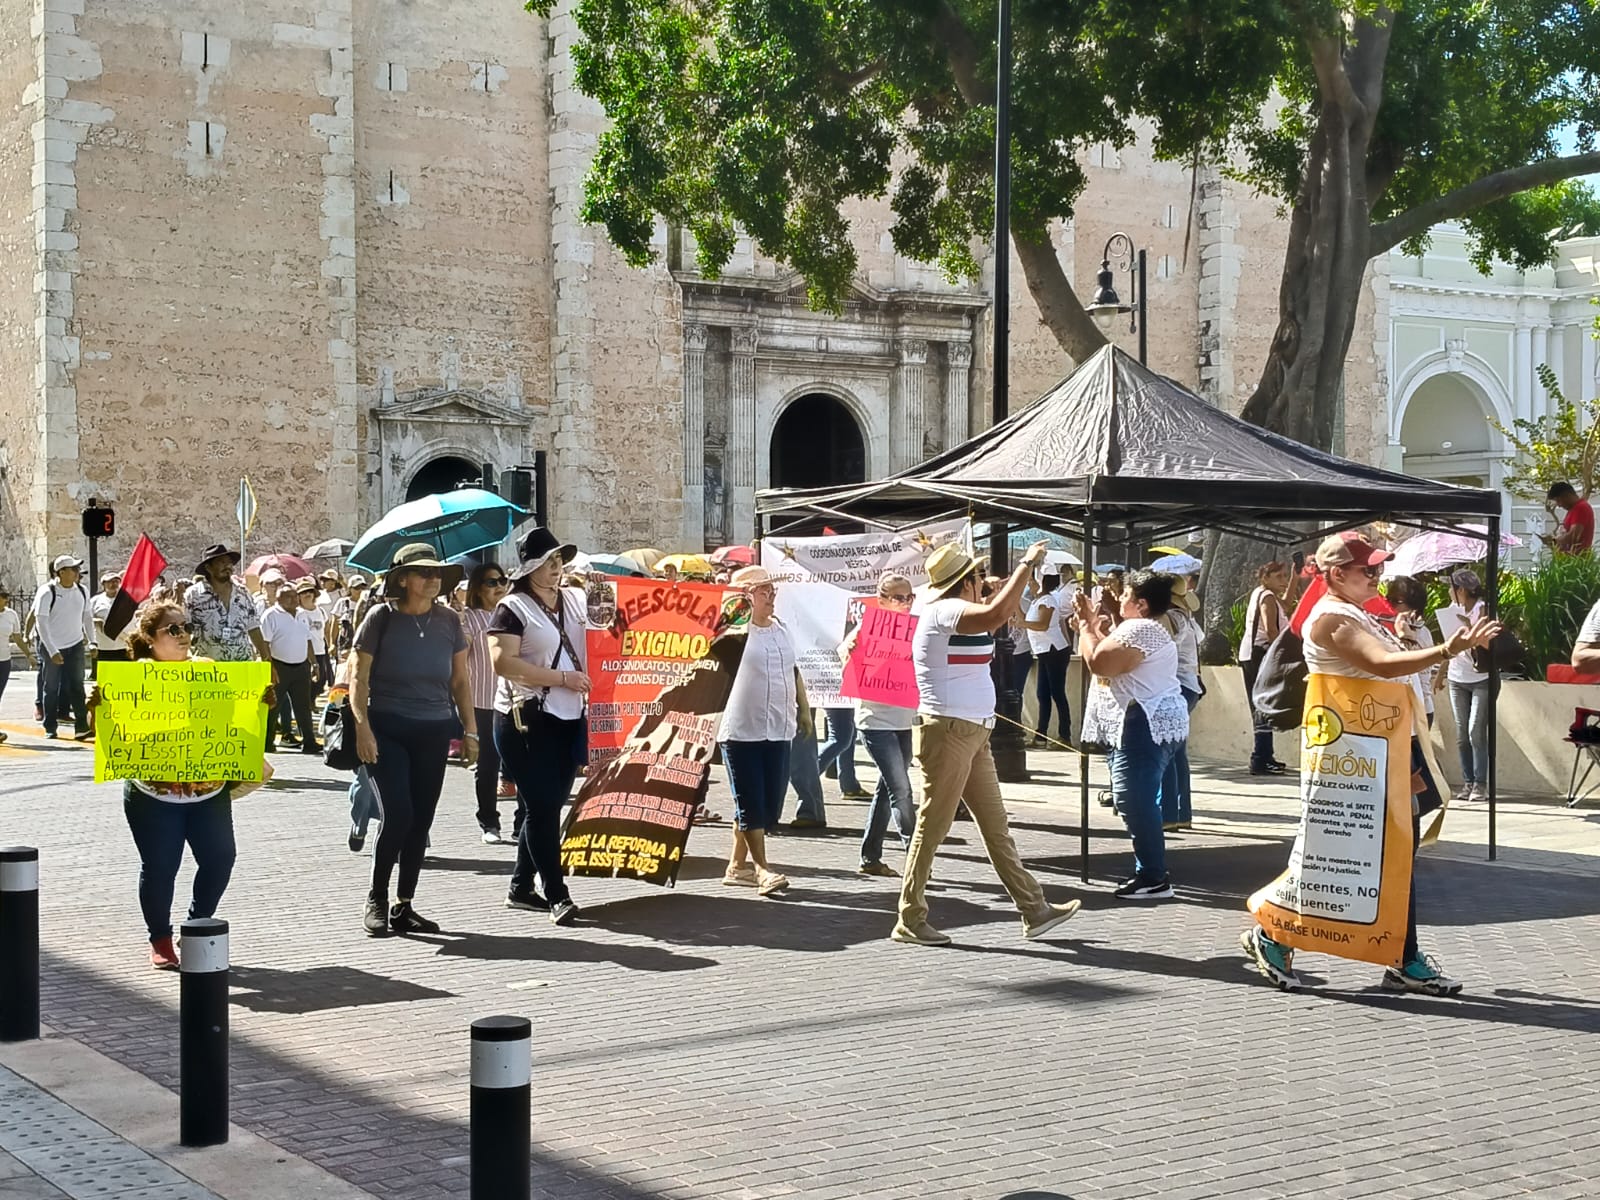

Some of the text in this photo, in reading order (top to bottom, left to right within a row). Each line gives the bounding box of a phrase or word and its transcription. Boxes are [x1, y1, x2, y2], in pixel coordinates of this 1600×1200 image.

[104, 514, 112, 531] 2
[810, 542, 902, 559] COORDINADORA REGIONAL DE
[805, 572, 847, 583] JUNTOS
[850, 572, 856, 580] A
[857, 570, 871, 580] LA
[144, 663, 228, 682] Presidenta
[622, 660, 671, 672] SINDICATOS
[652, 674, 666, 685] DE
[101, 683, 259, 709] Cumple tus promesas
[103, 705, 120, 719] de
[636, 702, 663, 716] TIEMPO
[701, 717, 714, 733] DE
[110, 723, 238, 746] Abrogación de la
[108, 740, 248, 761] ley ISSSTE 2007
[104, 760, 239, 773] Abrogación Reforma
[177, 770, 208, 781] PEÑA
[222, 769, 256, 781] AMLO
[1308, 807, 1374, 820] DENUNCIA PENAL
[1355, 803, 1375, 811] SNTE
[1309, 817, 1340, 826] docentes
[1359, 822, 1374, 830] solo
[1323, 828, 1351, 837] derecho
[591, 834, 607, 849] LA
[608, 835, 667, 858] REFORMA
[668, 846, 680, 861] A
[567, 851, 588, 866] DEL
[589, 851, 627, 868] ISSSTE
[627, 854, 659, 873] 2025
[1329, 857, 1361, 866] maestros
[1357, 886, 1379, 899] NO
[1283, 920, 1309, 937] BASE
